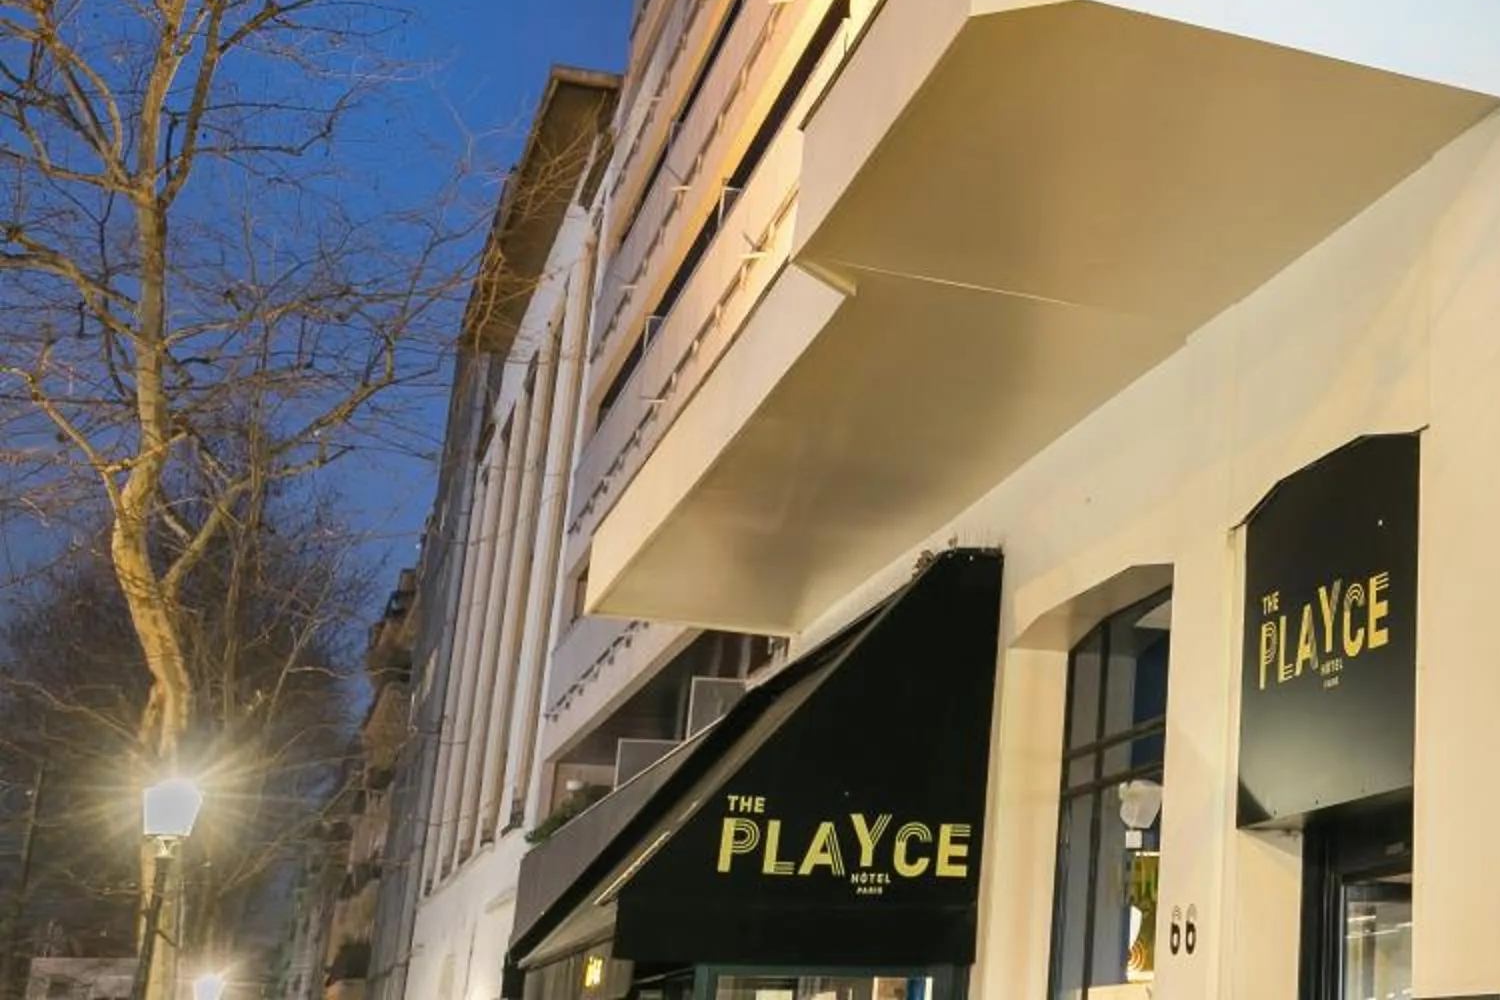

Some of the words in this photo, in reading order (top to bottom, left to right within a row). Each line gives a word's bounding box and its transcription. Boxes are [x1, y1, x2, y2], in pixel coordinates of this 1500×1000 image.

[1262, 591, 1279, 617] THE
[1259, 571, 1389, 690] PLAYCE
[727, 795, 766, 812] THE
[717, 813, 971, 877] PLAYCE
[856, 886, 883, 895] PARIS
[1170, 903, 1197, 955] 66
